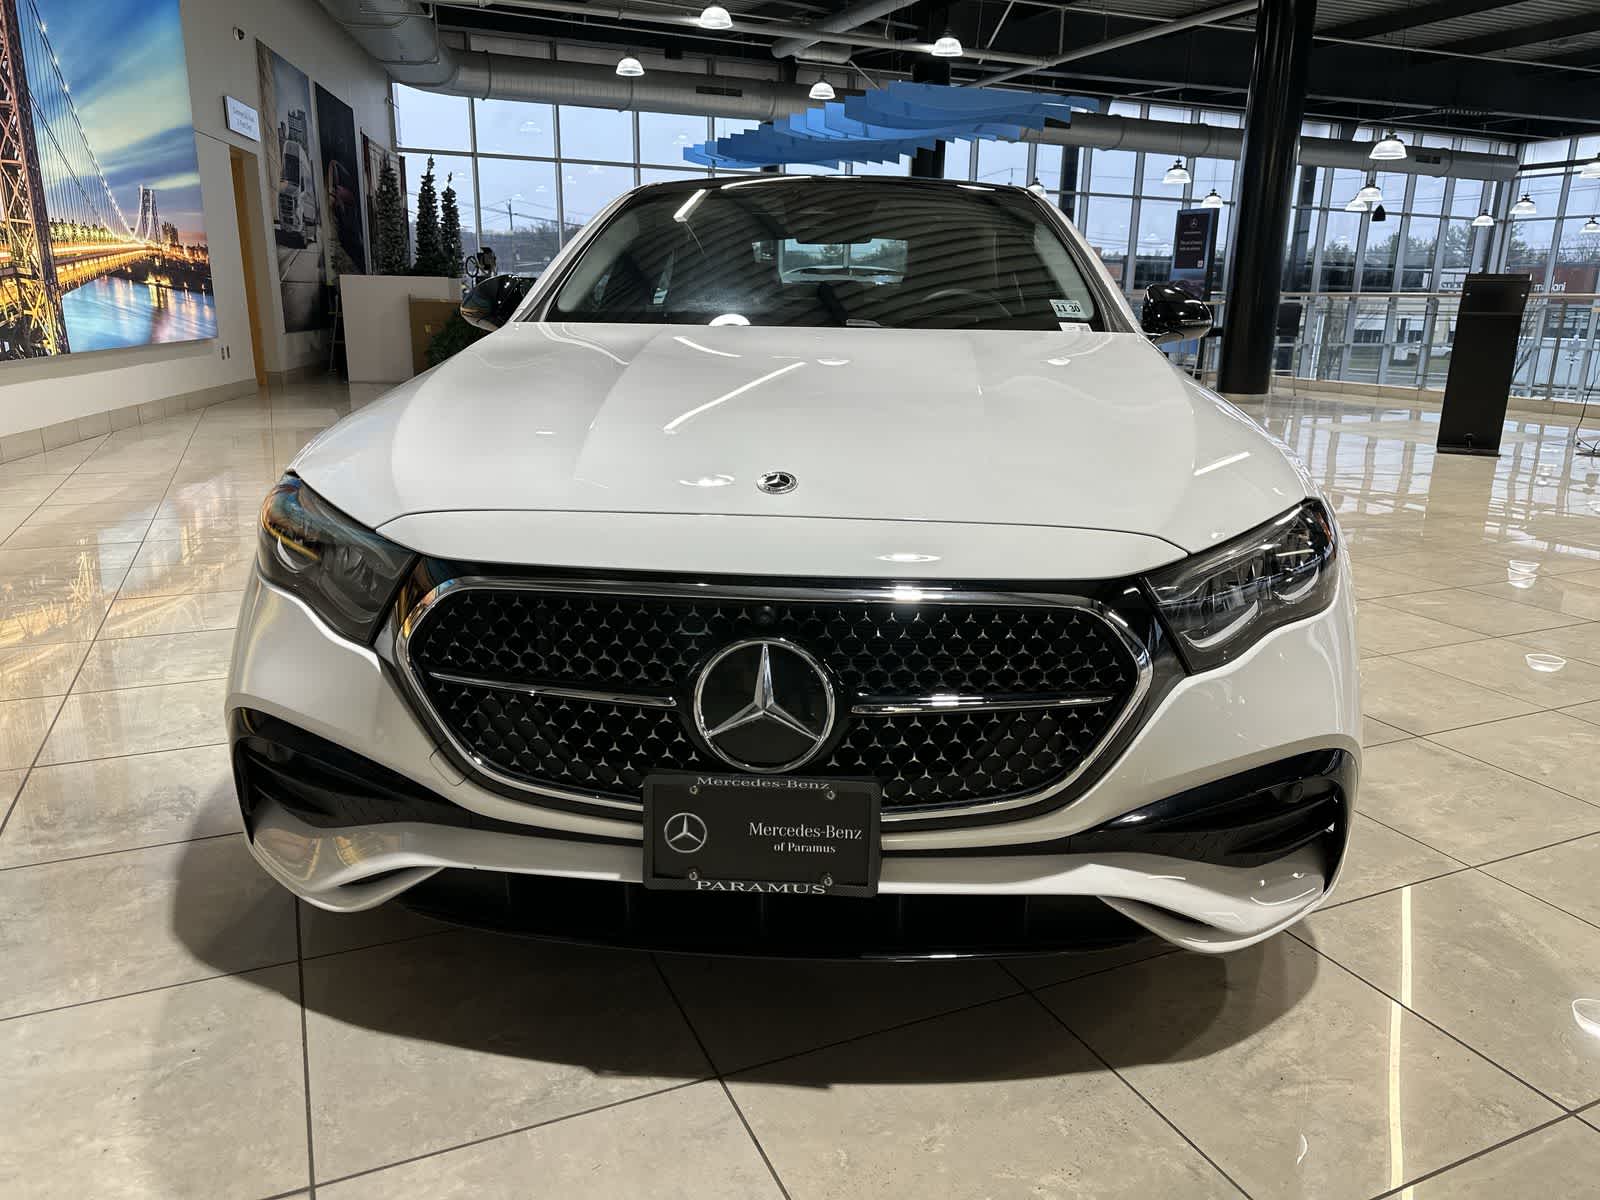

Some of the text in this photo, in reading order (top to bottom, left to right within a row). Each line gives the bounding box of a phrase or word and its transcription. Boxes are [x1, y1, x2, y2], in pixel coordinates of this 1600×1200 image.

[696, 777, 832, 790] Mercedes-Benz
[749, 821, 863, 840] Mercedes-Benz
[774, 842, 837, 854] of Paramus
[695, 880, 827, 895] PARAMUS
